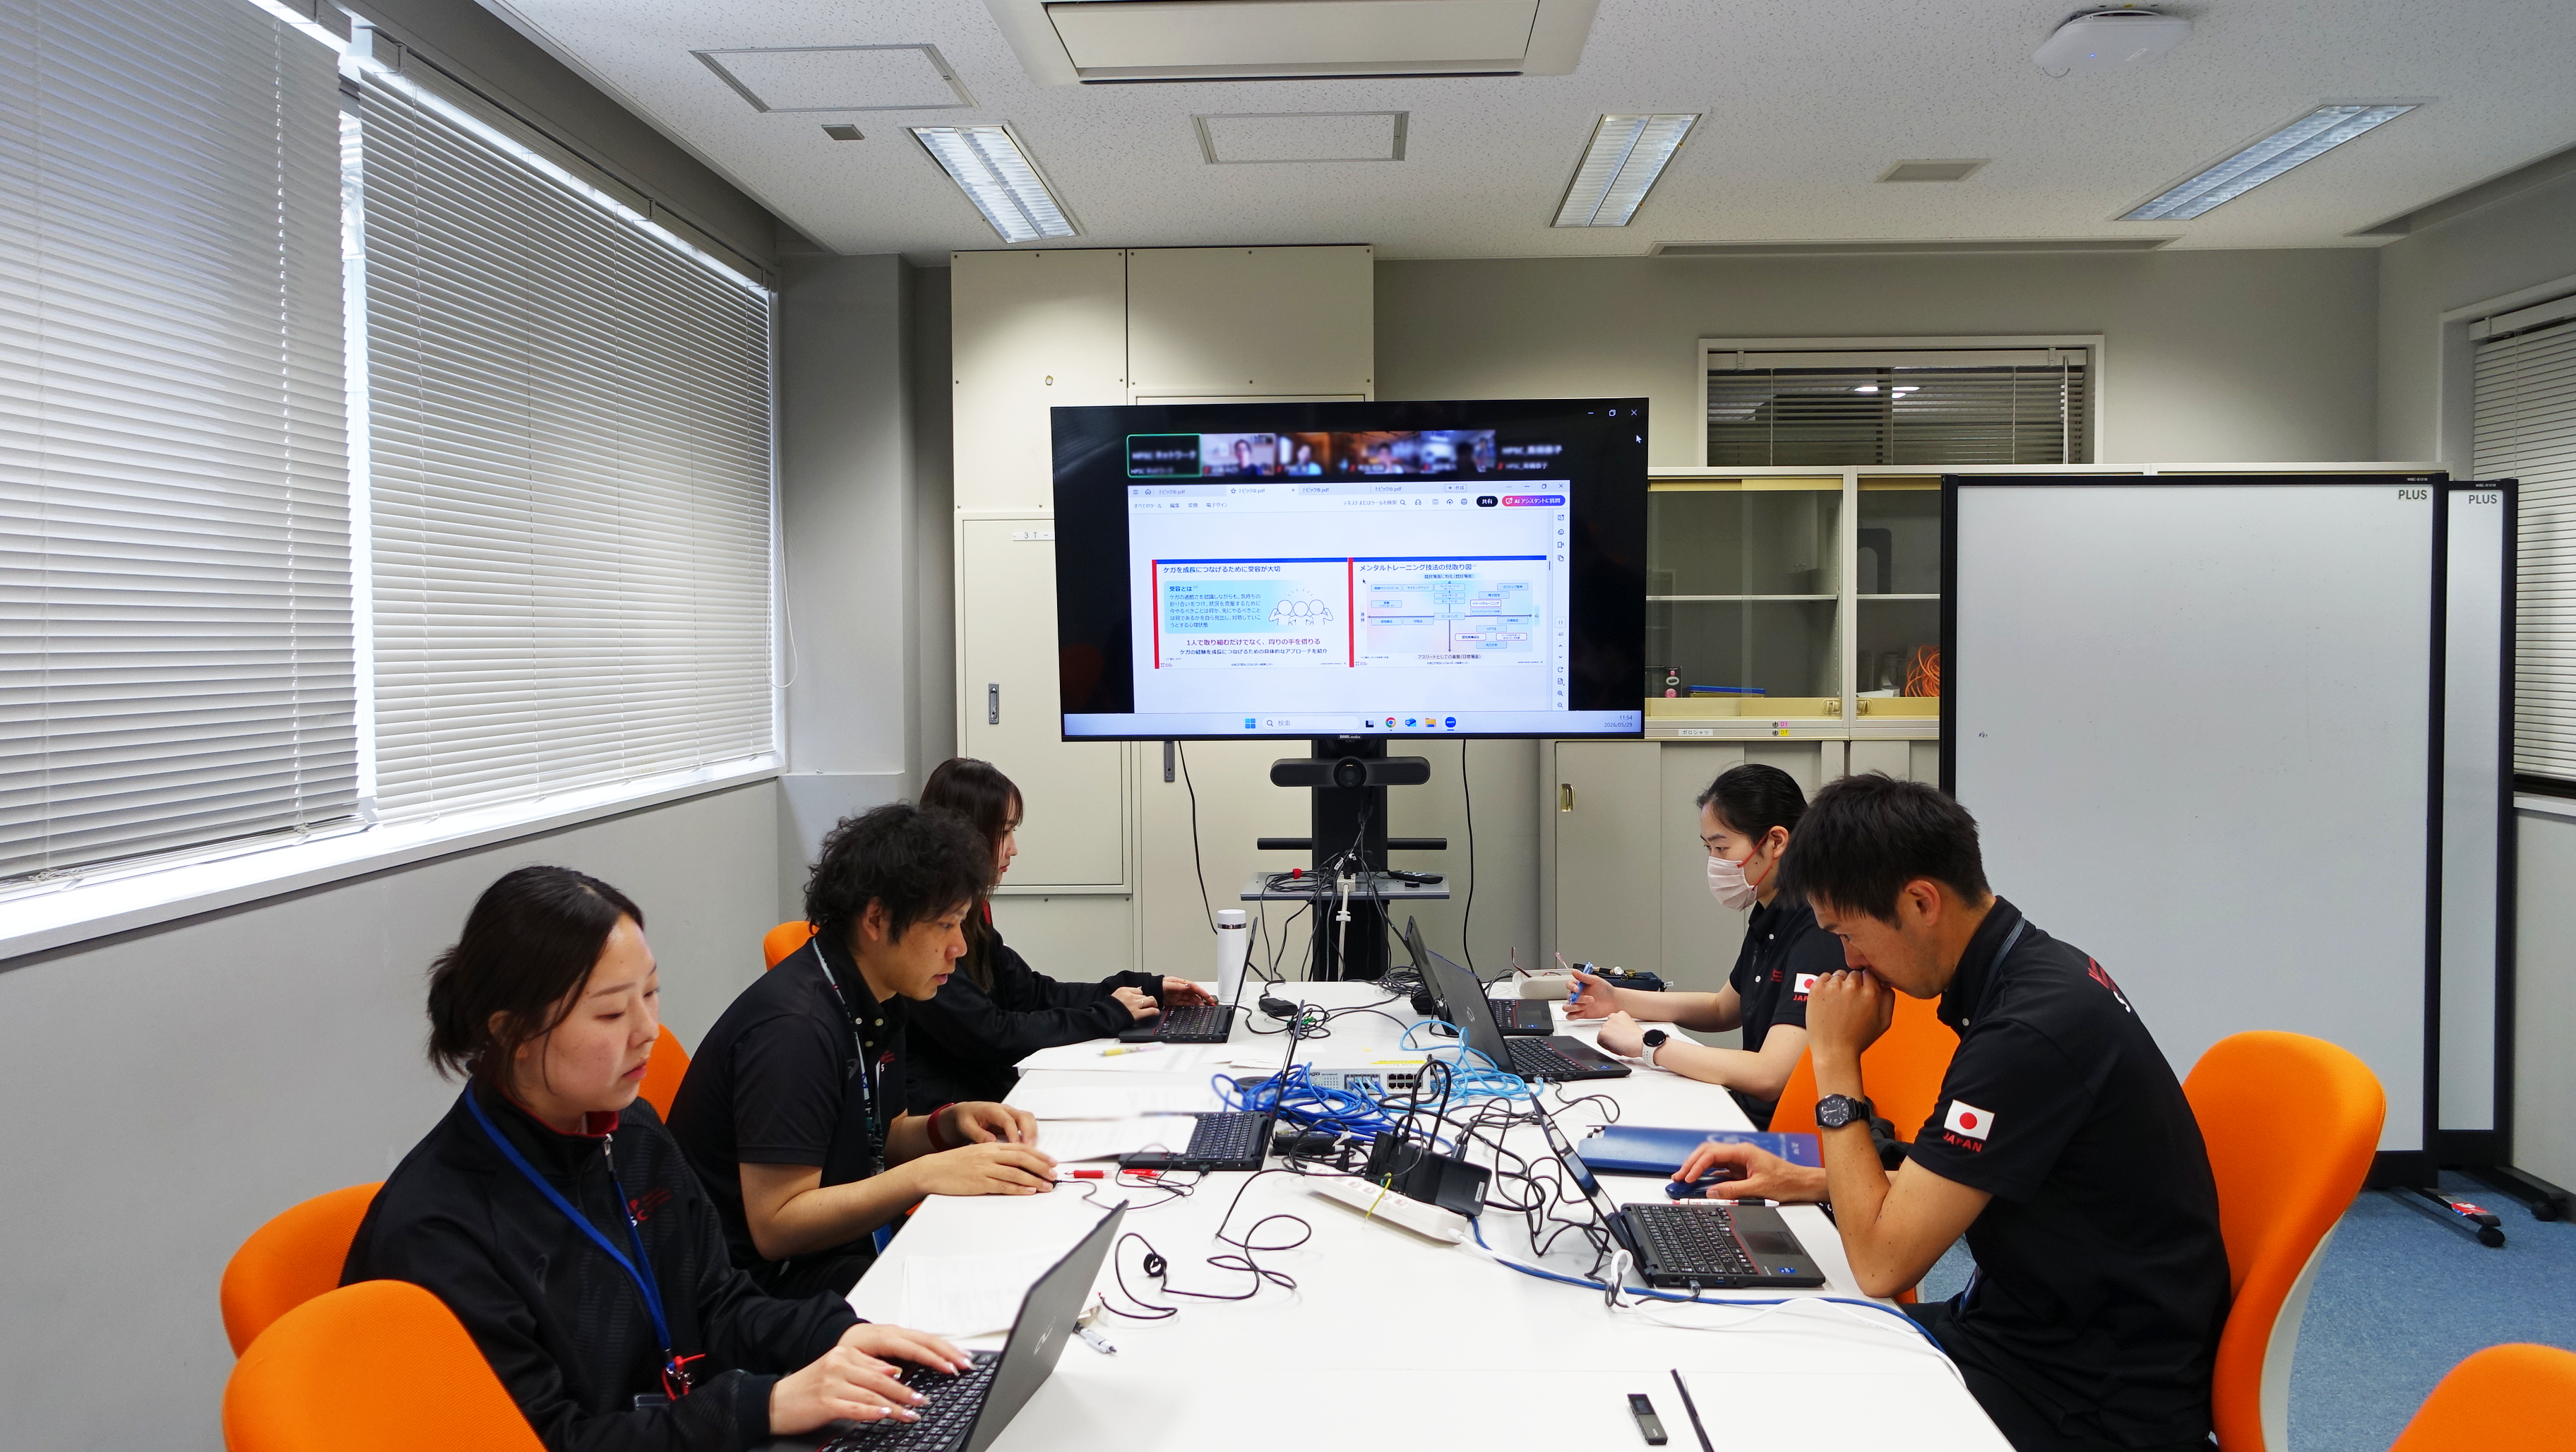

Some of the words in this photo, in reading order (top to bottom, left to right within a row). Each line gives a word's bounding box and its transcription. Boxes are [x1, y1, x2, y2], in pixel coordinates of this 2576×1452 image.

[2398, 489, 2427, 499] PLUS
[2469, 494, 2497, 504] PLUS
[1943, 1131, 1982, 1153] JAPAN
